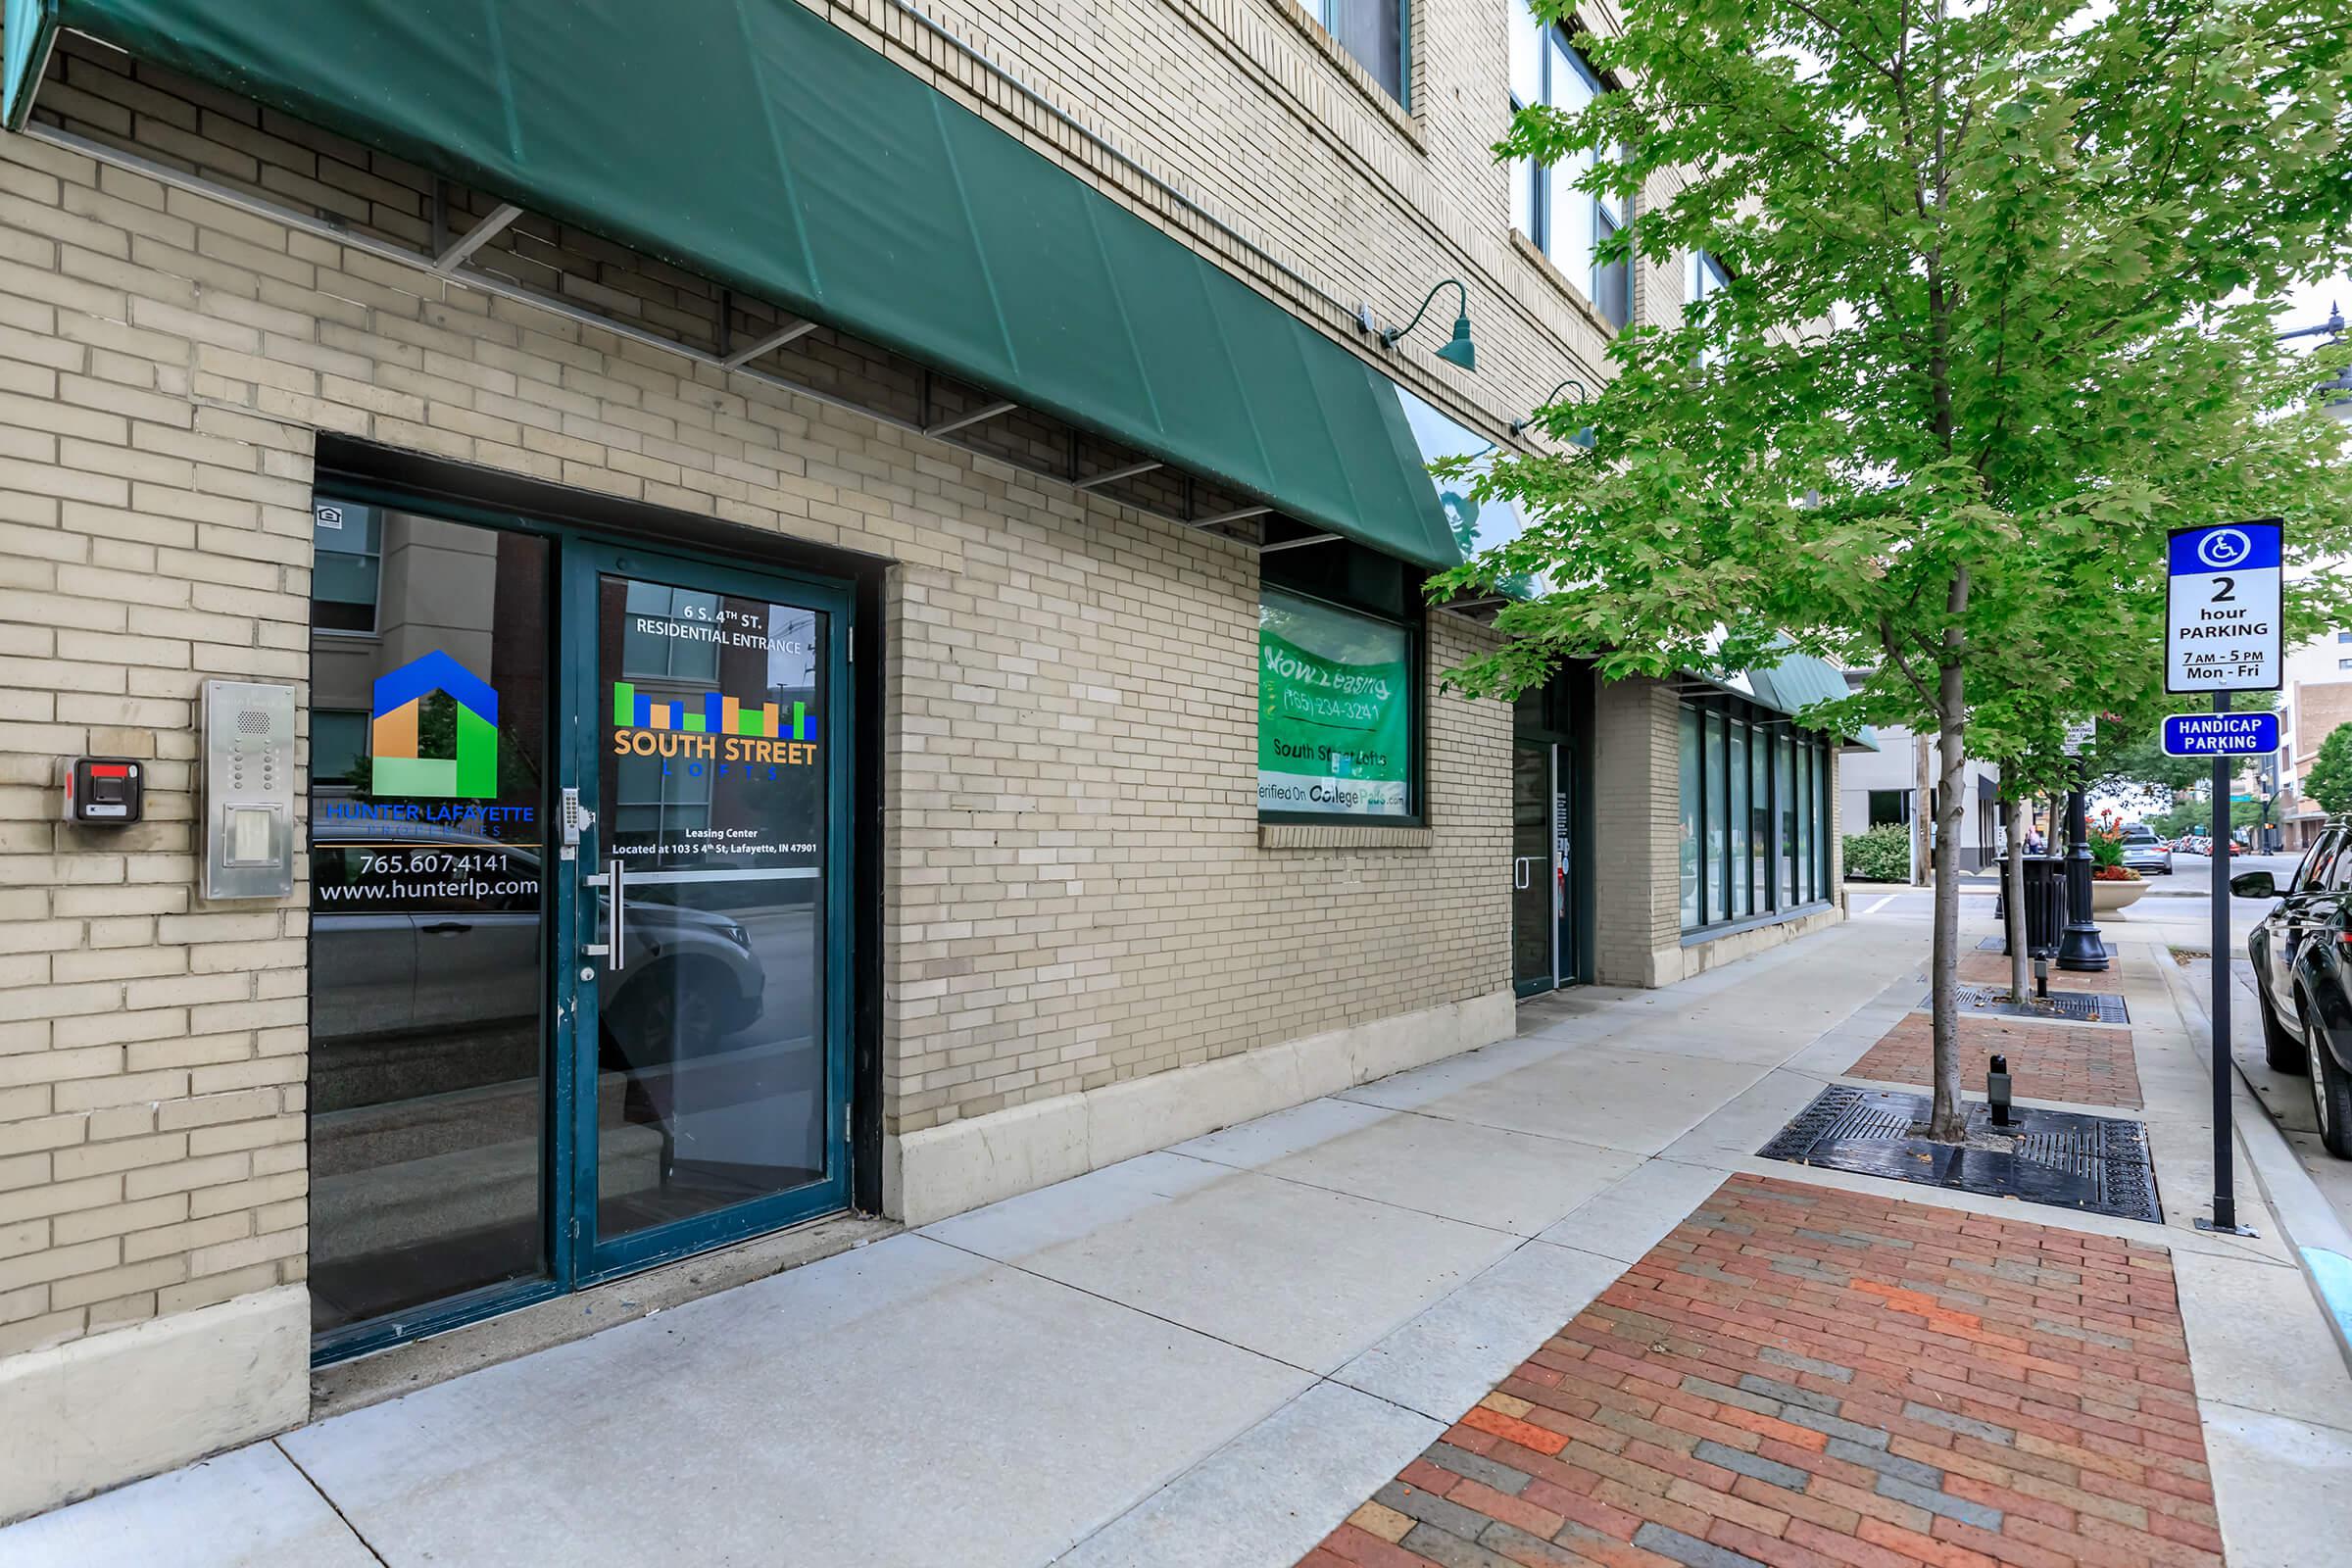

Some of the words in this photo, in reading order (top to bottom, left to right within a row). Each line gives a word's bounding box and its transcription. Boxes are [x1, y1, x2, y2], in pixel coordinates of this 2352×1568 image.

[2211, 577, 2235, 603] 2
[683, 606, 693, 617] 6
[698, 607, 711, 621] S.
[715, 610, 737, 623] 4TH
[741, 614, 762, 629] ST.
[2200, 609, 2247, 620] hour
[637, 618, 729, 645] RESIDENTIAL
[733, 633, 801, 655] ENTRANCE
[2180, 623, 2268, 639] PARKING
[2183, 653, 2193, 663] 7
[2195, 653, 2216, 663] AM
[2230, 651, 2239, 662] 5
[2243, 651, 2264, 662] PM
[2186, 667, 2224, 679] Mon
[2237, 664, 2259, 677] Fri
[1315, 666, 1392, 701] Leasing
[2180, 719, 2262, 734] HANDICAP
[613, 729, 715, 760] SOUTH
[724, 737, 817, 765] STREET
[1274, 739, 1314, 760] South
[1356, 750, 1387, 766] Lofts
[2184, 736, 2257, 750] PARKING
[662, 759, 777, 781] LOFTS
[1257, 783, 1292, 800] erified
[1294, 786, 1307, 801] On
[326, 803, 419, 820] HUNTER
[426, 805, 534, 822] LAFAYETTE
[686, 828, 724, 840] Leasing
[726, 828, 758, 839] Center
[612, 844, 656, 854] Located
[659, 845, 669, 854] at
[671, 844, 690, 854] 103
[692, 844, 699, 854] S
[701, 844, 714, 854] 4th
[715, 844, 728, 855] St,
[730, 844, 777, 855] Lafayette,
[778, 844, 789, 853] IN
[790, 844, 816, 853] 47901
[360, 855, 509, 874] 765.607.4141
[319, 878, 538, 901] www.hunterlp.com
